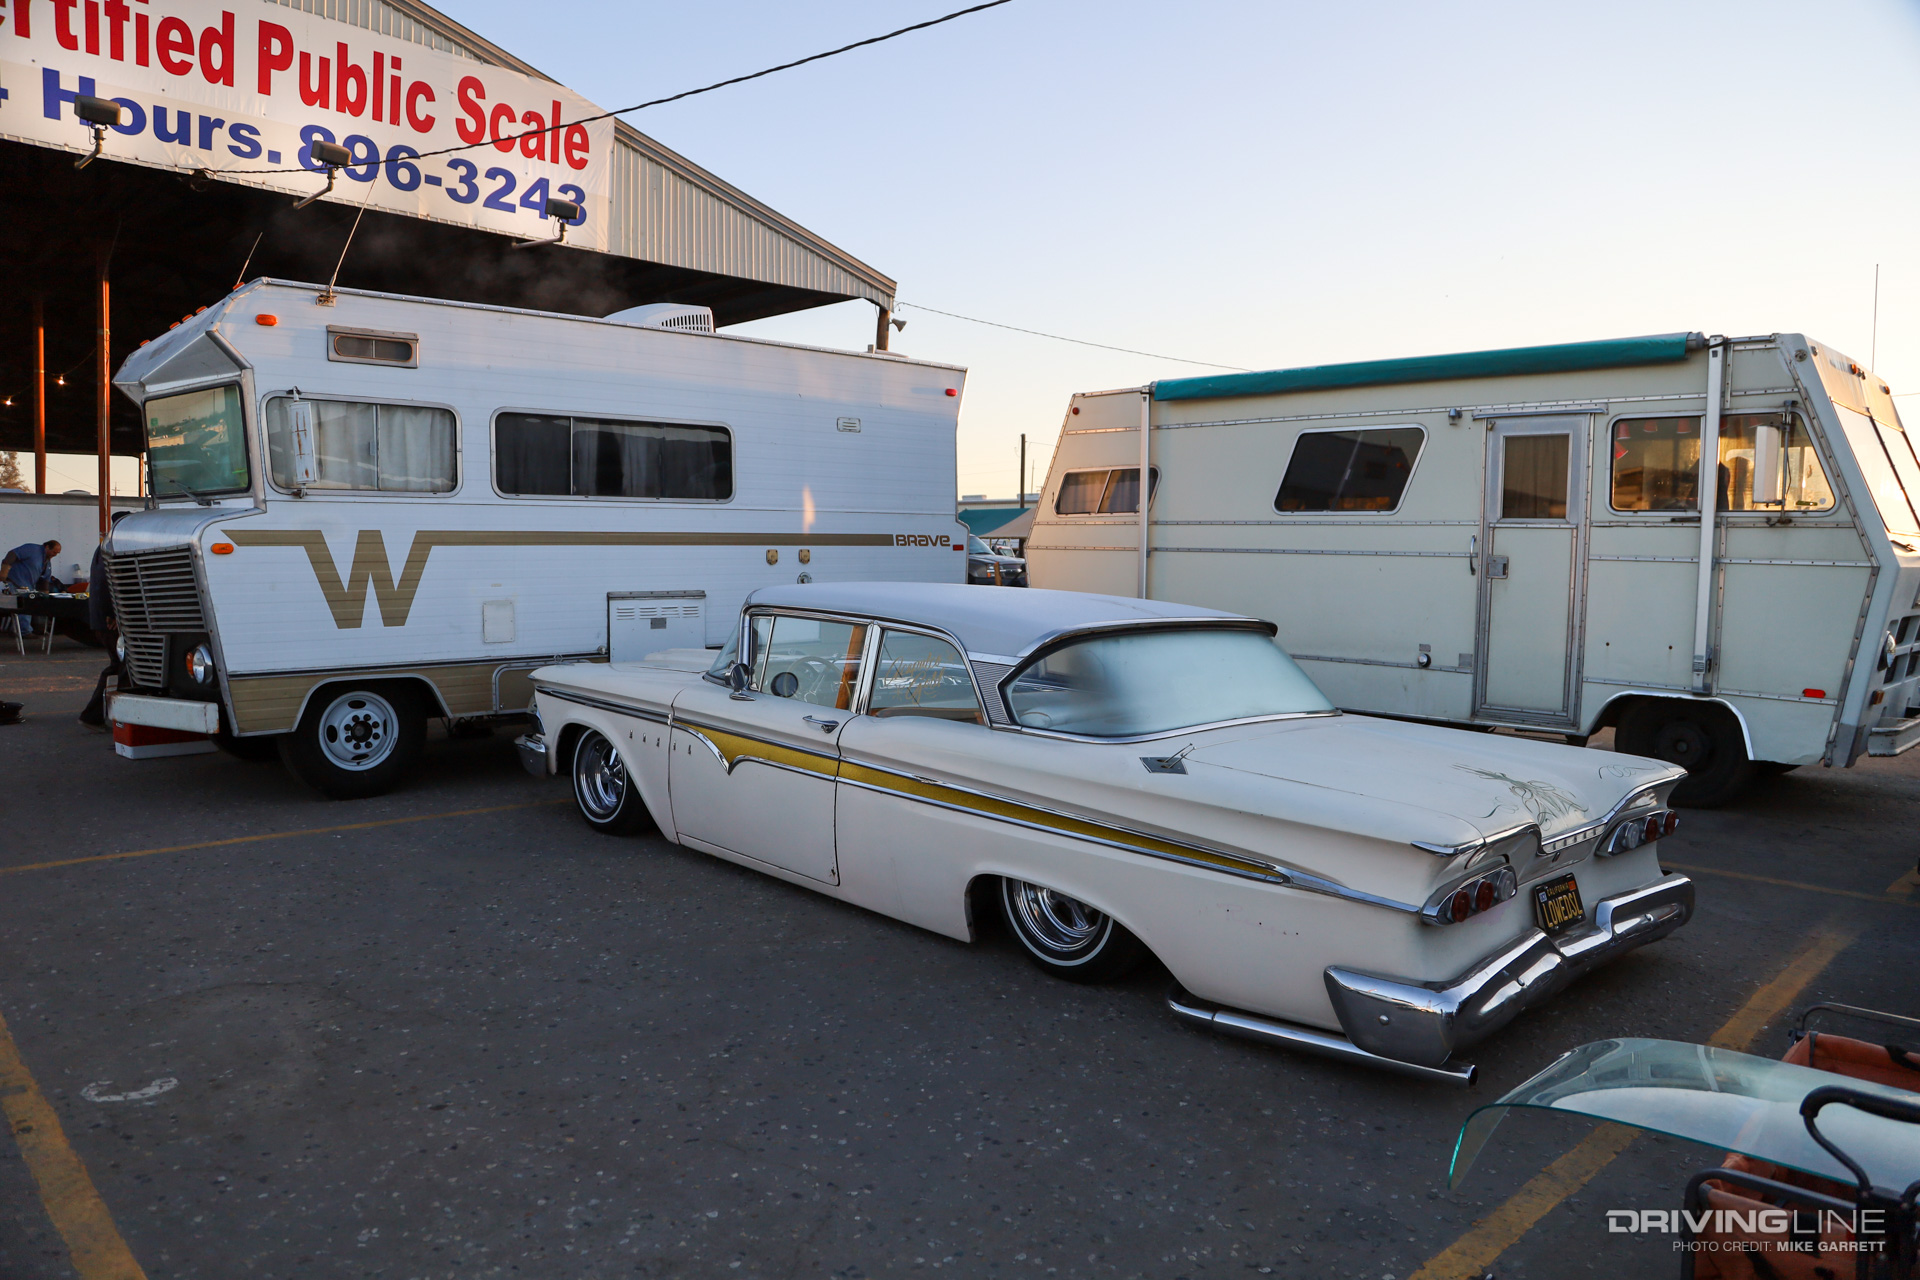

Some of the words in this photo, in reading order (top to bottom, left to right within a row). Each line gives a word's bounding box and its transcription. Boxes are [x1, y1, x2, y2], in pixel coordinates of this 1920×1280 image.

[0, 0, 235, 87] rtified
[257, 20, 437, 134] Public
[455, 75, 590, 171] Scale
[297, 124, 587, 227] 896-3243
[303, 529, 434, 630] W
[1542, 892, 1583, 928] LOWEDSL
